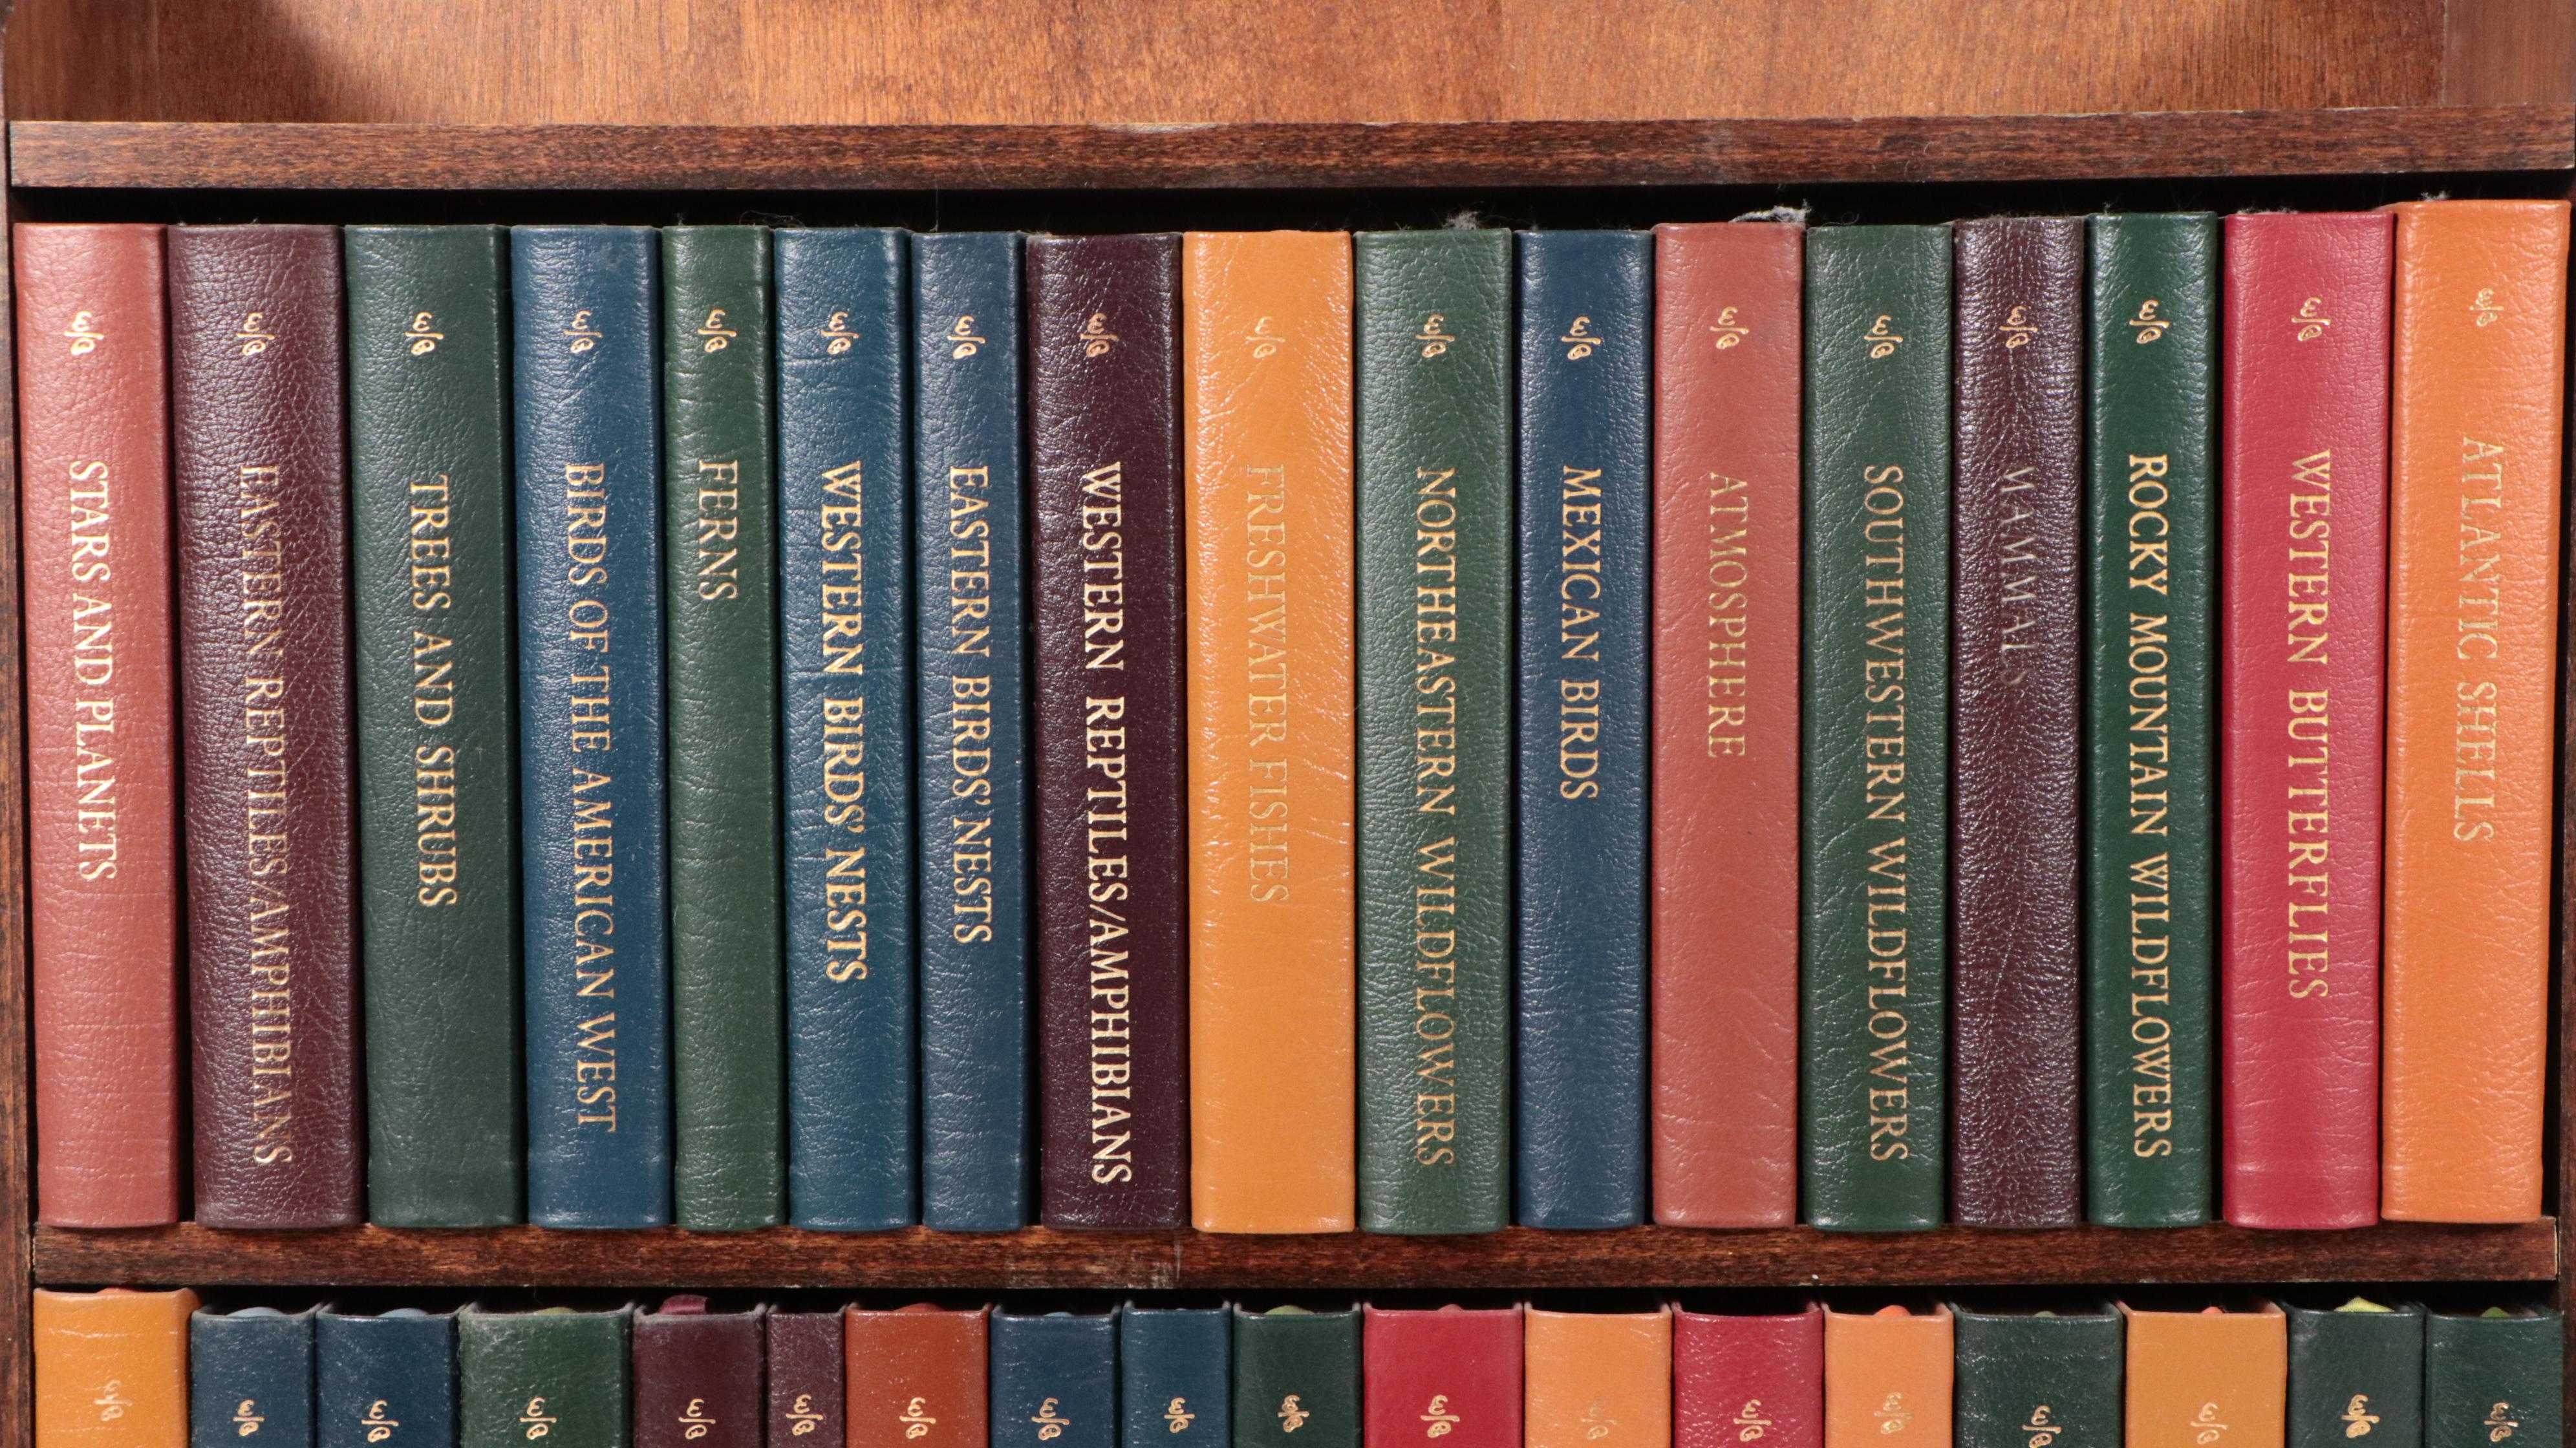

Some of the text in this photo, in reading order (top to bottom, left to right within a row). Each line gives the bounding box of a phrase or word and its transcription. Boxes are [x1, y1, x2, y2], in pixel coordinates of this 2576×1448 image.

[69, 460, 116, 880] STARS AND PLANETS
[239, 465, 279, 657] EASTERN
[410, 476, 455, 908] TREES AND SHRUBS
[698, 459, 737, 601] FERNS
[820, 462, 866, 984] WESTERN BIRDS' NESTS
[949, 465, 992, 944] EASTERN BIRDS' NESTS
[1082, 462, 1122, 672] WESTERN
[1246, 465, 1289, 903] FRESHWATER FISHES
[1560, 466, 1600, 800] MEXICAN BIRDS
[1707, 473, 1750, 756] ATMOSPHERE
[2287, 449, 2331, 999] WESTERN BUTTERFLIES
[2451, 436, 2504, 842] ATLANTIC SHELLS
[564, 465, 615, 1131] BIRDS OF THE AMERICAN WEST
[1415, 467, 1455, 1166] NORTHEASTERN WILDFLOWERS
[1864, 465, 1907, 1162] SOUTHWESTERN WILDFLOWERS
[2129, 455, 2171, 1158] ROCKY MOUNTAIN WILDFLOWERS
